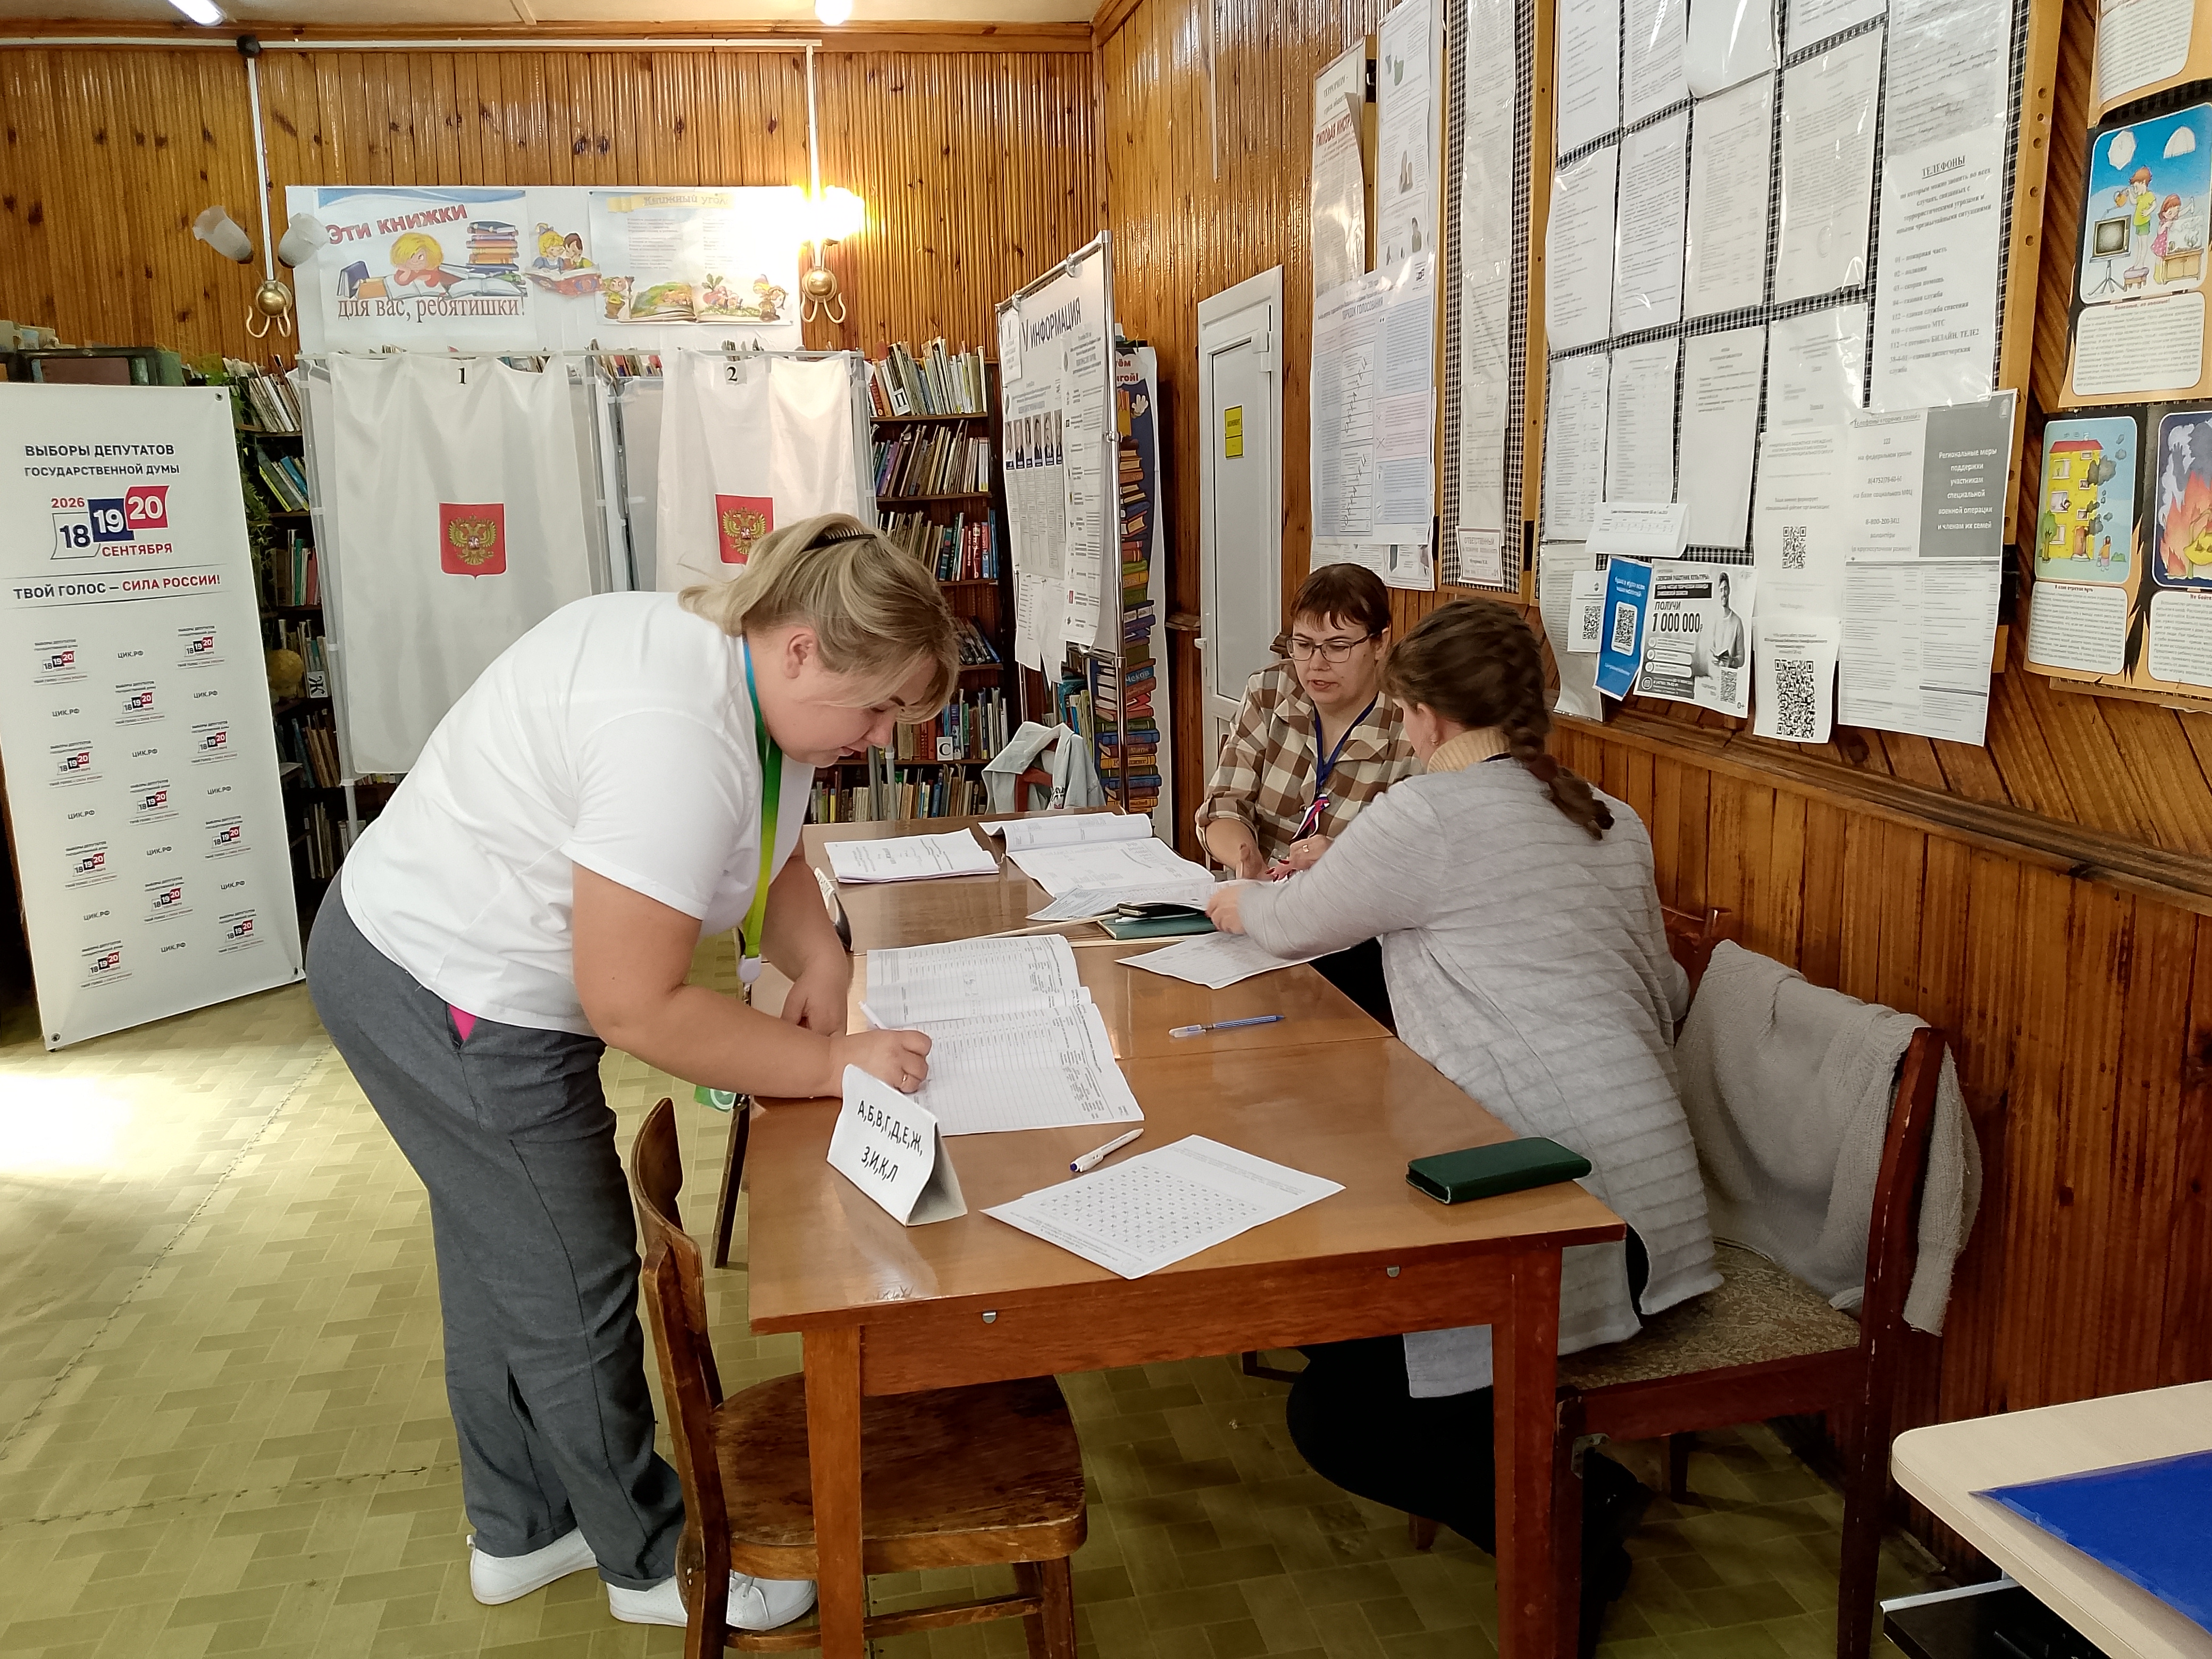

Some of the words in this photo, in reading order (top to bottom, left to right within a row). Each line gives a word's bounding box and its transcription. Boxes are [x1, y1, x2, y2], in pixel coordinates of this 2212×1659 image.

[1922, 155, 1965, 177] ТЕЛЕФОНЫ
[1978, 167, 1991, 177] всех
[643, 195, 698, 206] Книжный
[328, 223, 371, 245] Эти
[377, 203, 468, 234] книжки
[1924, 291, 1943, 301] служба
[338, 299, 370, 321] для
[376, 300, 411, 321] вас,
[416, 295, 525, 323] ребятишки!
[1924, 306, 1943, 315] служба
[1944, 301, 1969, 311] спасения
[1030, 296, 1082, 349] ИНФОРМАЦИЯ
[1932, 319, 1946, 328] МТС
[1960, 329, 1979, 338] ТЕЛЕ2
[457, 367, 467, 384] 1
[727, 366, 739, 382] 2
[25, 445, 89, 457] ВЫБОРЫ
[94, 445, 175, 458] ДЕПУТАТОВ
[1939, 450, 1979, 459] Региональные
[24, 463, 144, 477] ГОСУДАРСТВЕННОЙ
[146, 464, 180, 476] ДУМЫ
[1950, 463, 1984, 473] поддержки
[1950, 477, 1984, 487] участникам
[1947, 489, 1985, 500] специальной
[51, 498, 85, 509] 2026
[1938, 506, 1963, 515] военной
[1963, 506, 1993, 515] операции
[59, 524, 91, 548] 18
[93, 509, 124, 534] 19
[128, 495, 163, 520] 20
[1973, 521, 1992, 529] семей
[102, 543, 173, 557] СЕНТЯБРЯ
[13, 583, 54, 600] ТВОЙ
[58, 583, 106, 597] ГОЛОС
[122, 578, 160, 591] СИЛА
[162, 574, 221, 590] РОССИИ!
[1654, 601, 1681, 610] ПОЛУЧИ
[1660, 613, 1680, 632] 000
[118, 650, 144, 659] ЦИК.РФ
[308, 675, 325, 696] Ж
[52, 708, 80, 717] ЦИК.РФ
[132, 749, 158, 758] ЦИК.РФ
[939, 743, 951, 756] С
[207, 786, 232, 795] ЦИК.РФ
[68, 810, 95, 820] ЦИК.РФ
[146, 847, 172, 856] ЦИК.РФ
[221, 881, 245, 890] ЦИК.РФ
[83, 910, 110, 921] ЦИК.РФ
[161, 942, 186, 953] ЦИК.РФ
[861, 1146, 899, 1183] З,И,К,Л
